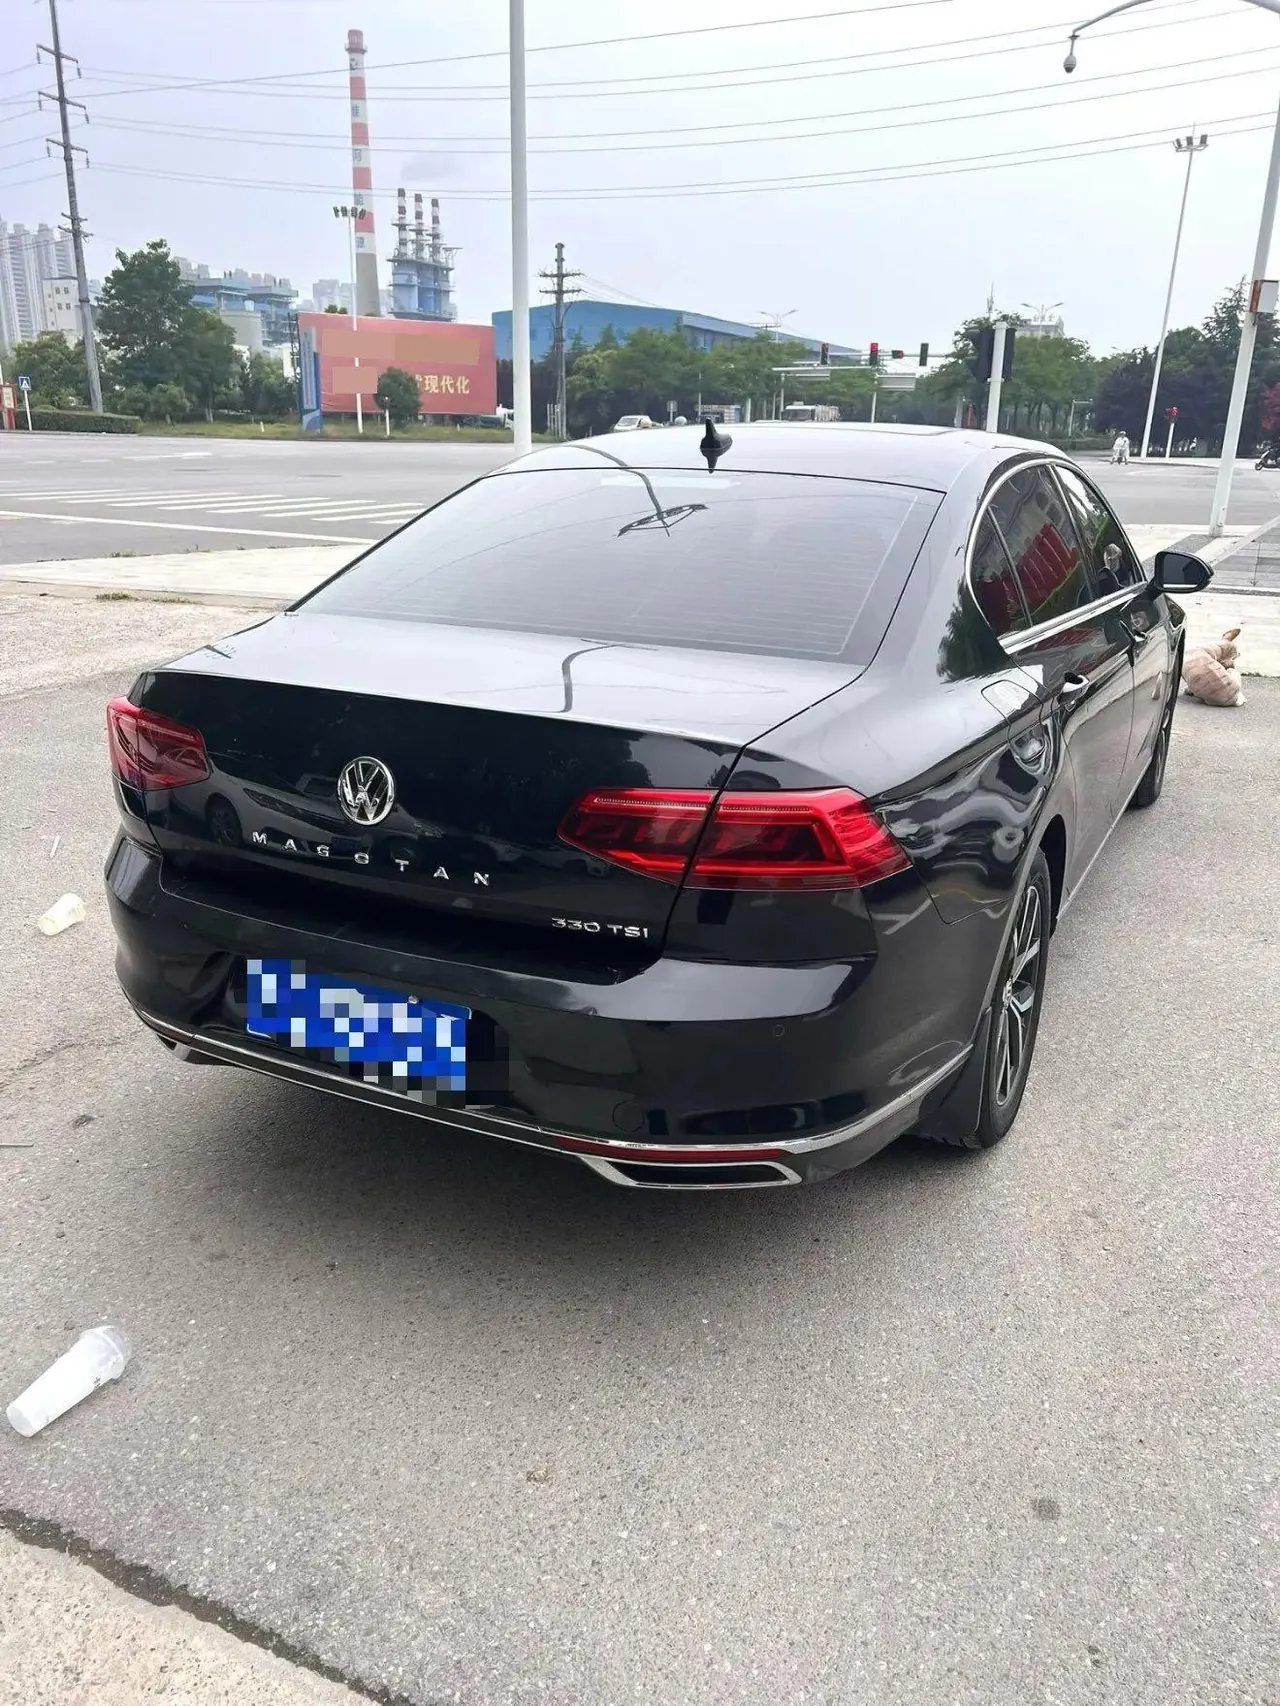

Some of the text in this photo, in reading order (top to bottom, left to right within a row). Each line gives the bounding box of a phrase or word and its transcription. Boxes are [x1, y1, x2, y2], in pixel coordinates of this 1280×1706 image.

[252, 831, 490, 886] MAGOTAN
[551, 917, 649, 940] 330 TSI
